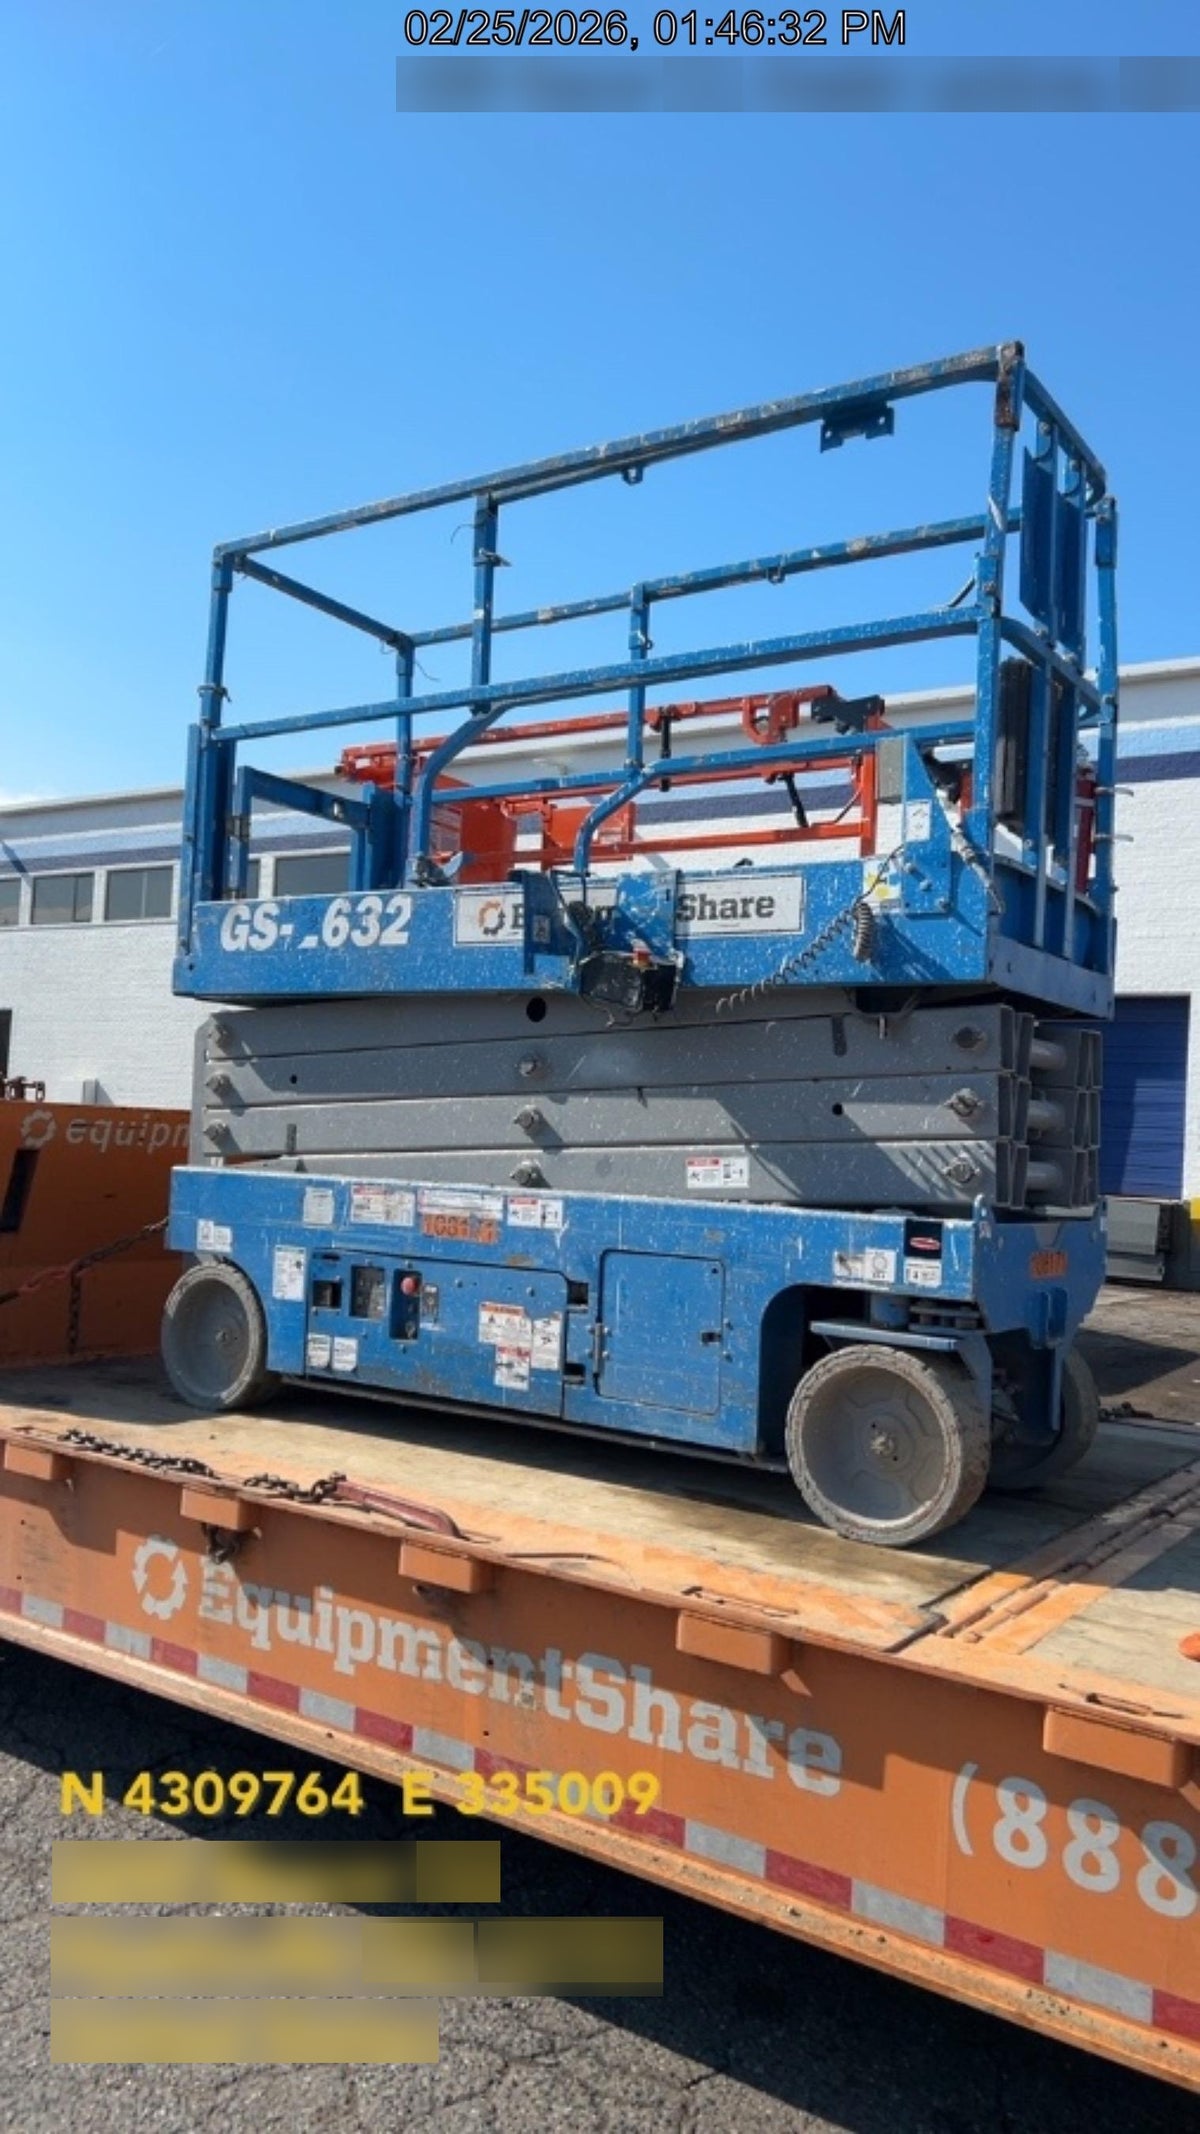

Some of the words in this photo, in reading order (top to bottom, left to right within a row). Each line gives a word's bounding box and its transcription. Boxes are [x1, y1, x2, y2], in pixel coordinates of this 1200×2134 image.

[220, 894, 413, 952] GS-632
[199, 1552, 844, 1798] EquipmentShare
[952, 1762, 1200, 1919] (888
